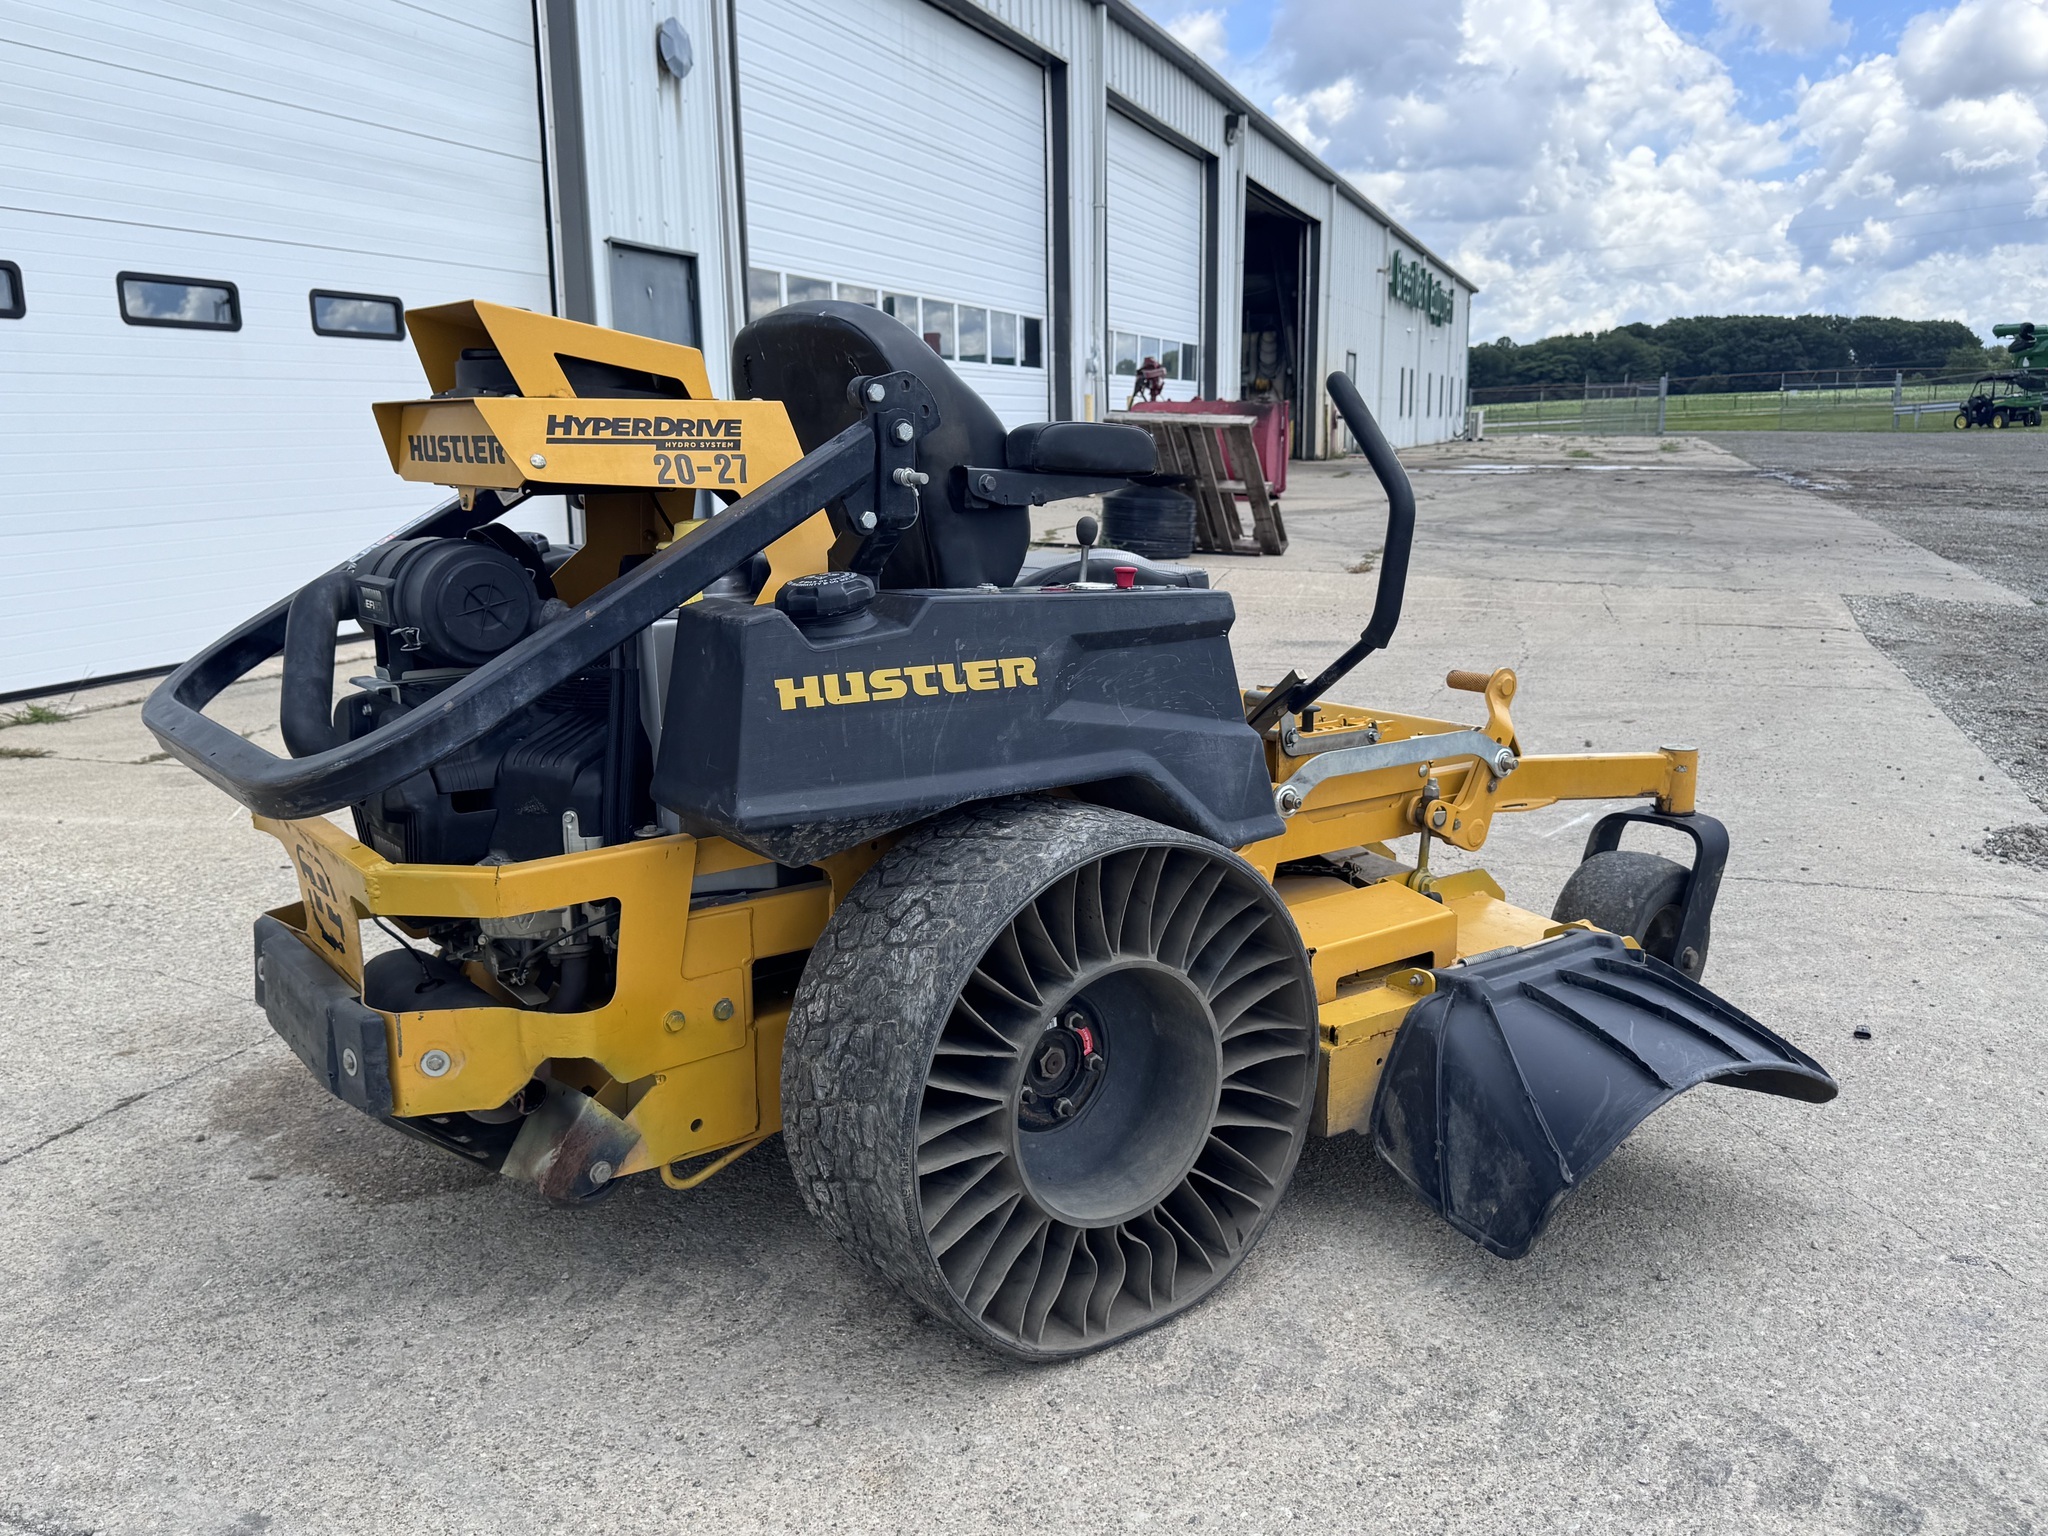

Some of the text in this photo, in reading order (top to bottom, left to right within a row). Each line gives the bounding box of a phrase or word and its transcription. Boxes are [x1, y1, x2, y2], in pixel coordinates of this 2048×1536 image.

[546, 415, 742, 438] HYPERDRIVE
[408, 435, 506, 464] HUSTLER
[653, 453, 748, 485] 20-27
[774, 656, 1038, 711] HUSTLER
